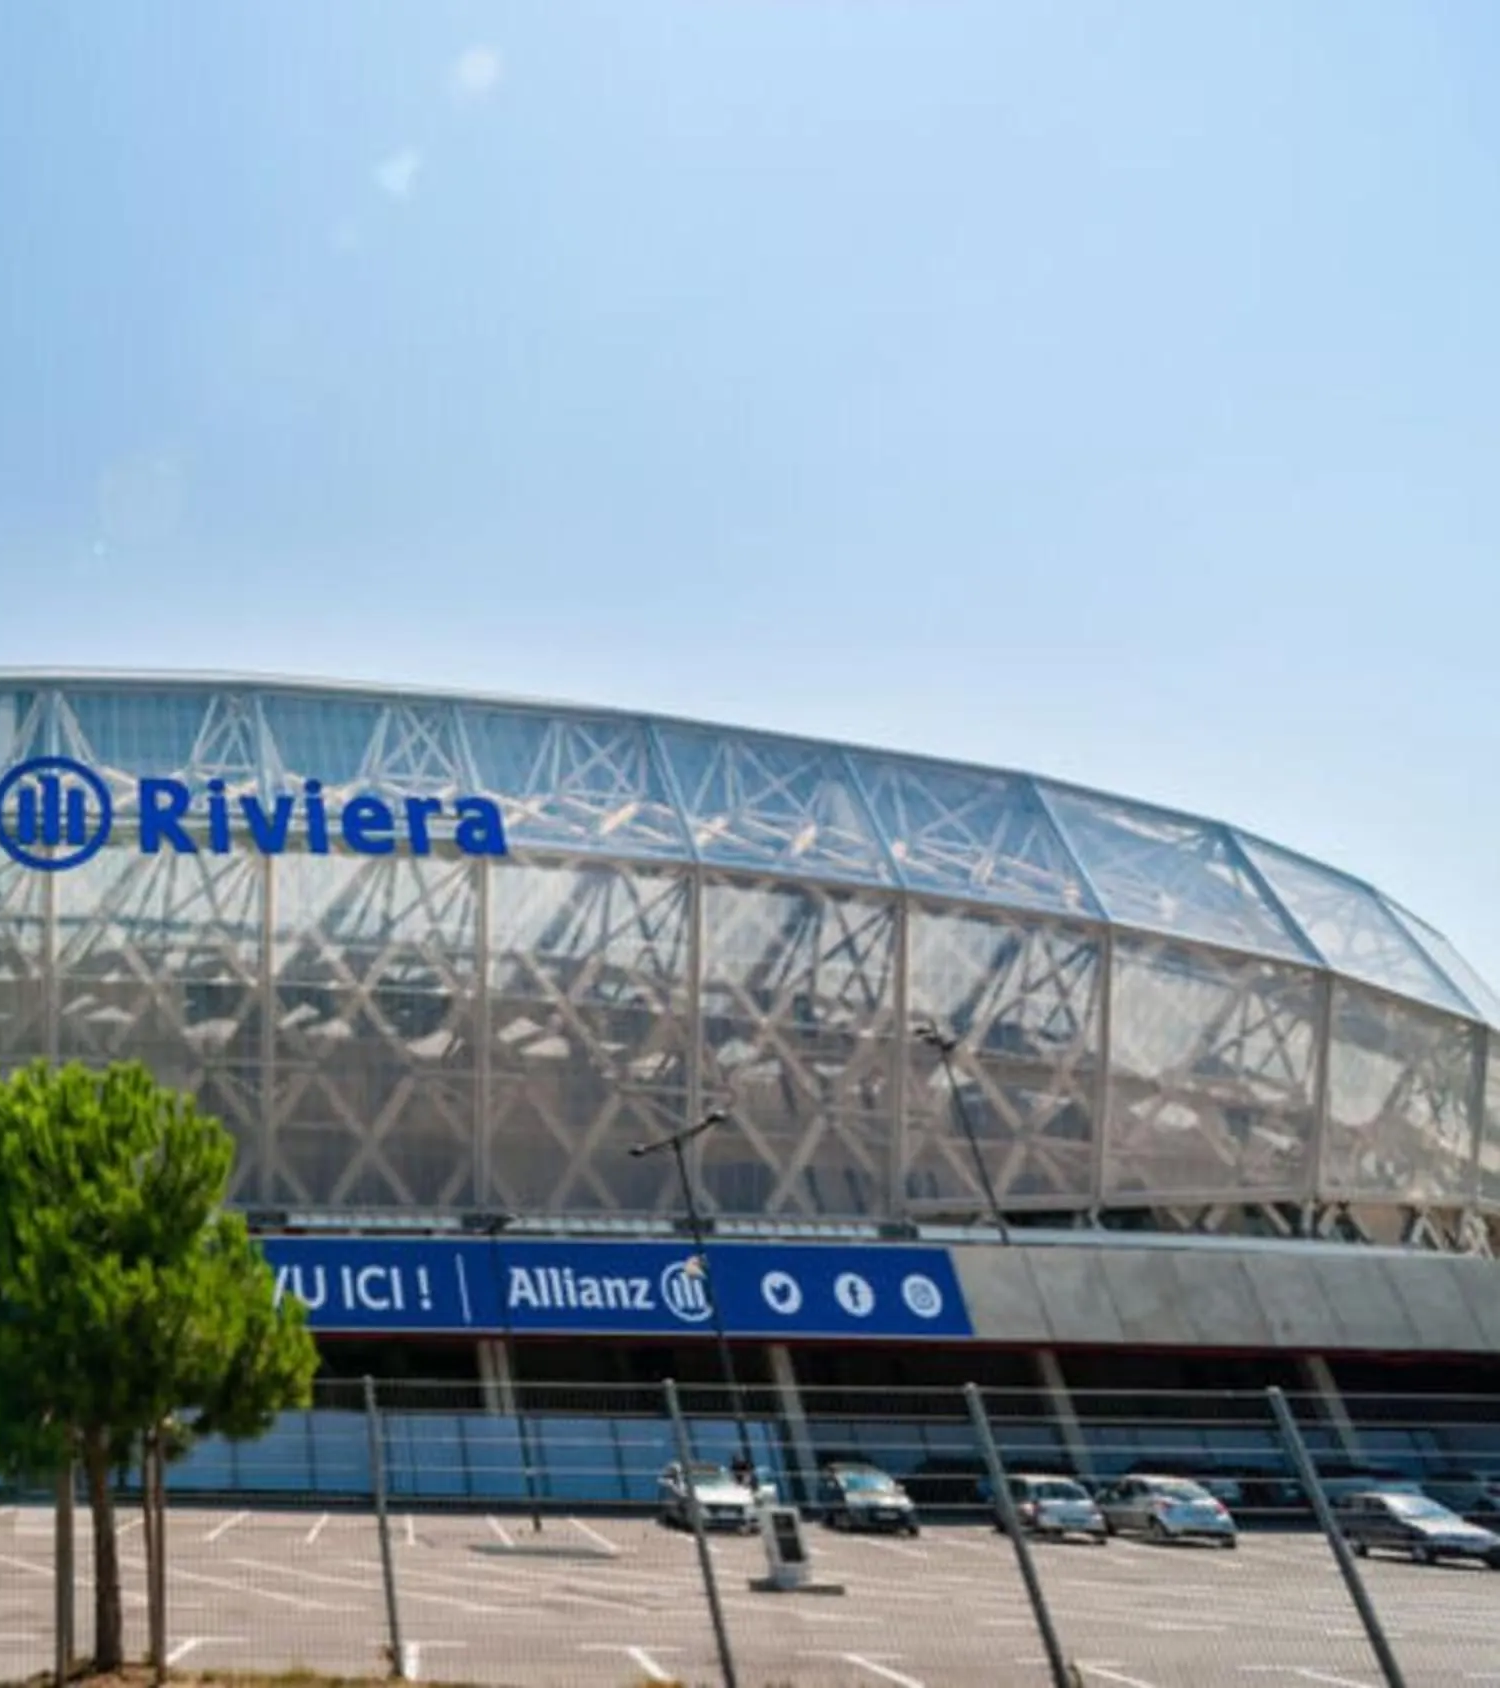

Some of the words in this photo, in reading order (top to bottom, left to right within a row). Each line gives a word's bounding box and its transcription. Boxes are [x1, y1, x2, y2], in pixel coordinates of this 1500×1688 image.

[137, 776, 509, 857] Riviera
[340, 1265, 406, 1311] ICI
[508, 1266, 655, 1310] Allianz
